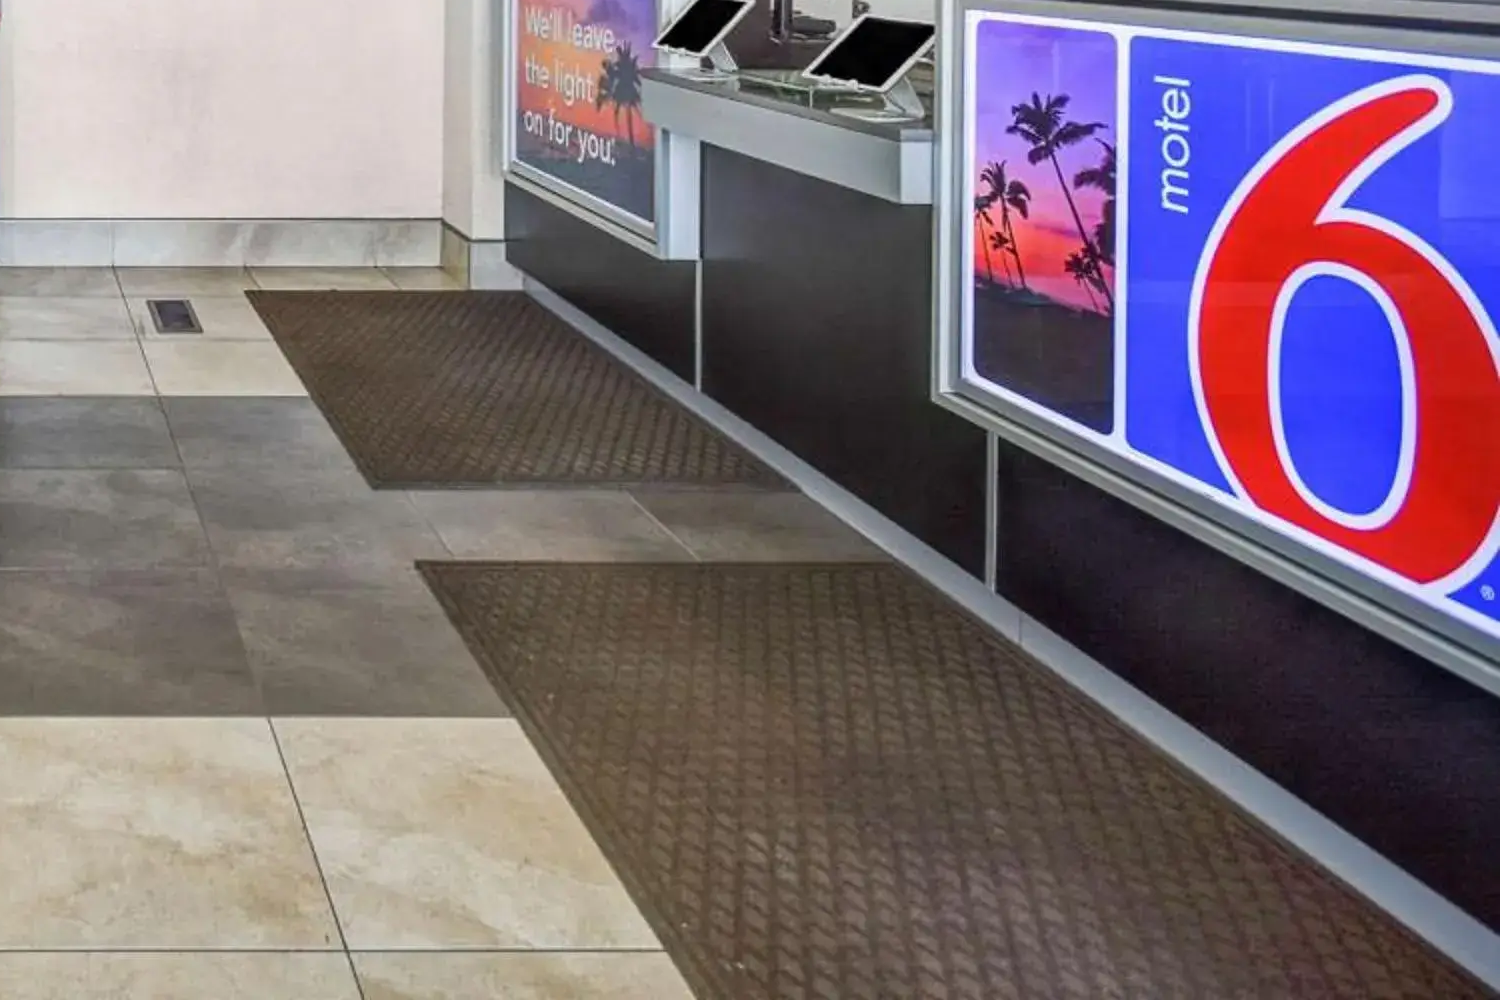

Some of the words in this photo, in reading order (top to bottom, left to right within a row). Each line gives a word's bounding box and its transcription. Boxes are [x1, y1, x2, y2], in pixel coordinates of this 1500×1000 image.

[525, 6, 562, 42] We'll
[568, 11, 614, 53] leave
[525, 55, 550, 89] the
[554, 59, 596, 106] light
[524, 111, 543, 137] on
[548, 107, 573, 147] for
[1153, 75, 1192, 215] motel
[1187, 73, 1500, 600] 6
